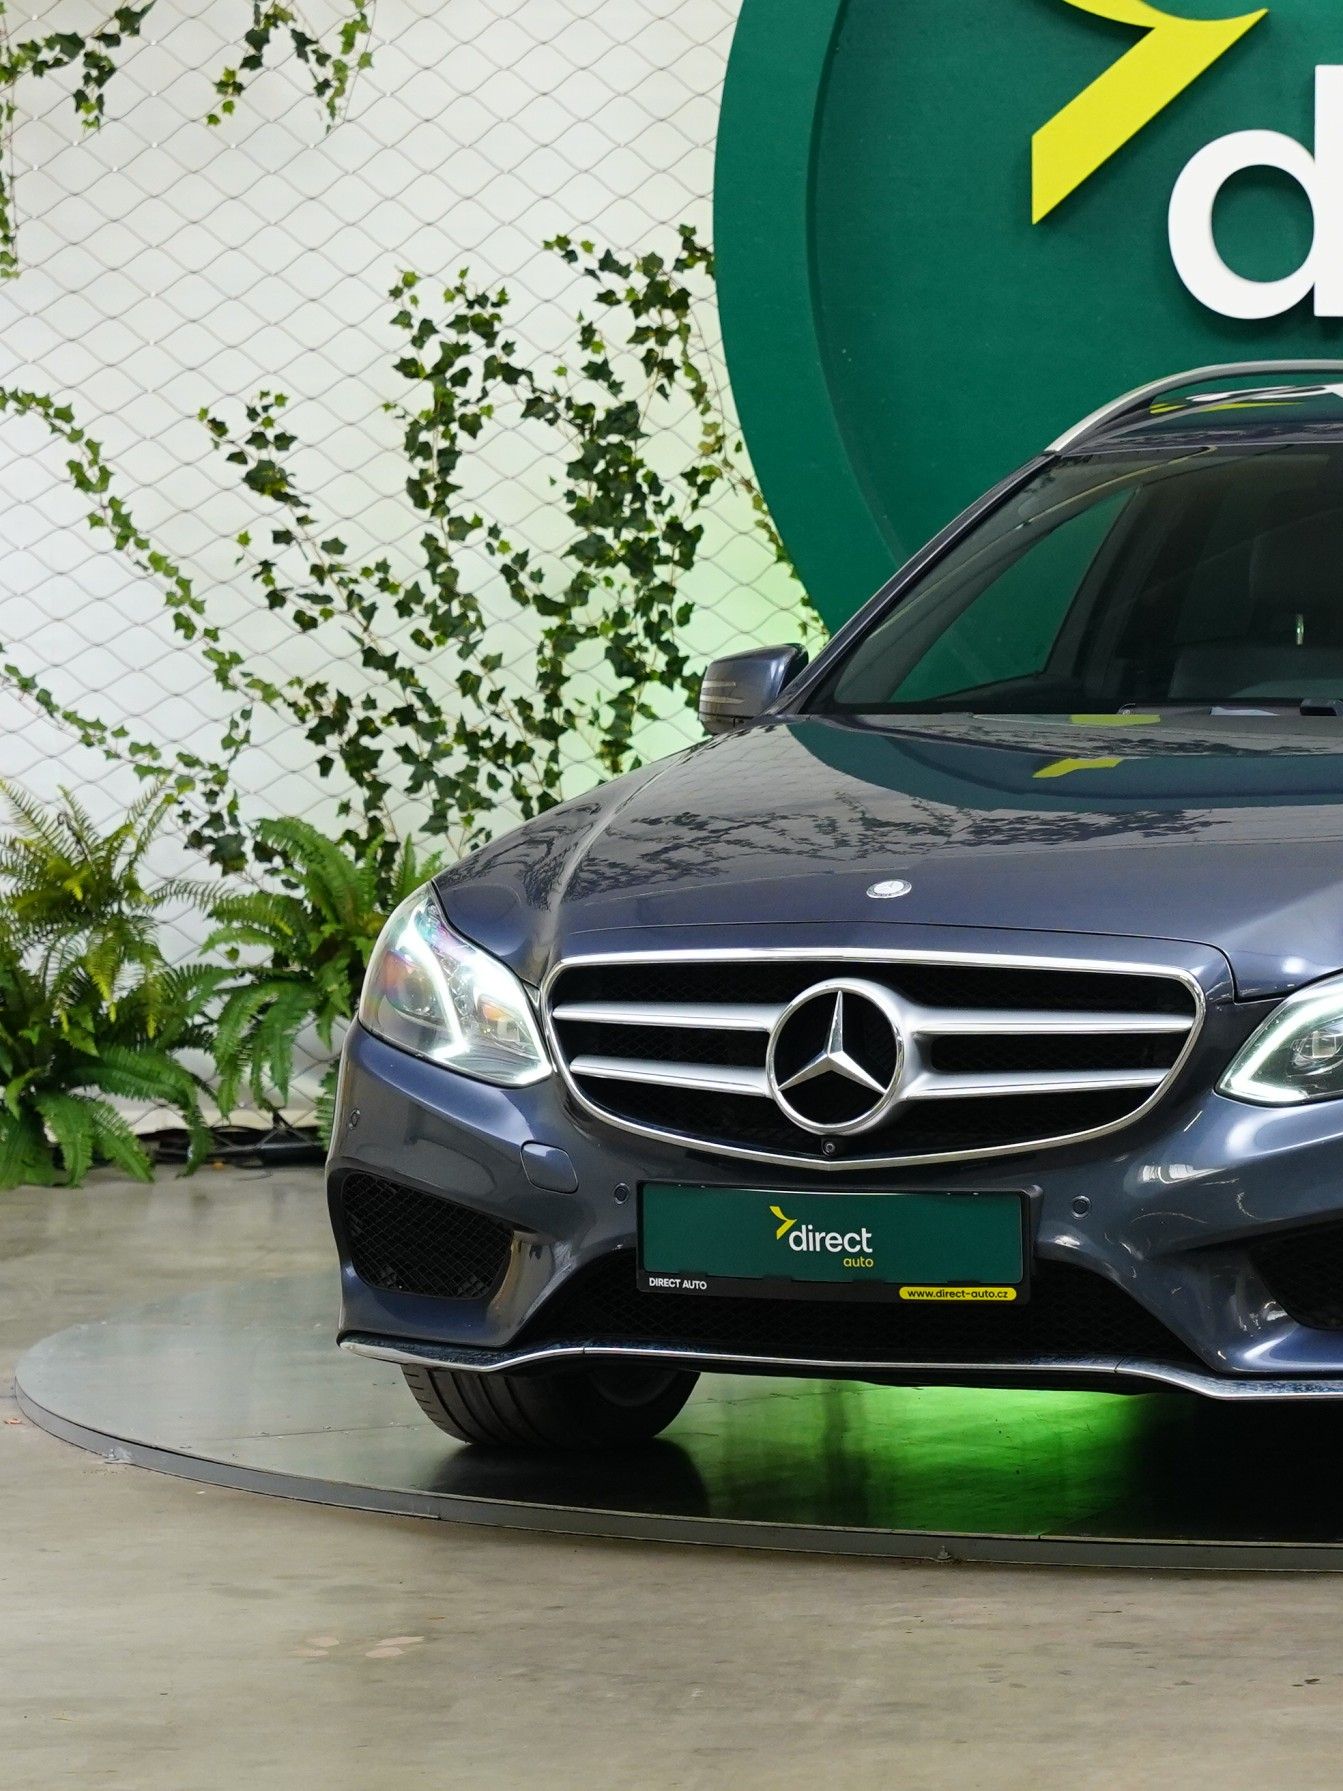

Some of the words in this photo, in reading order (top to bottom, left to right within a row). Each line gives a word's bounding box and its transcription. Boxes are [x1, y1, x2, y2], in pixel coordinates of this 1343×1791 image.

[788, 1224, 873, 1253] direct
[843, 1256, 874, 1268] auto
[649, 1277, 681, 1288] DIRECT
[682, 1279, 708, 1290] AUTO
[907, 1288, 1008, 1299] www.direct-auto.cz
